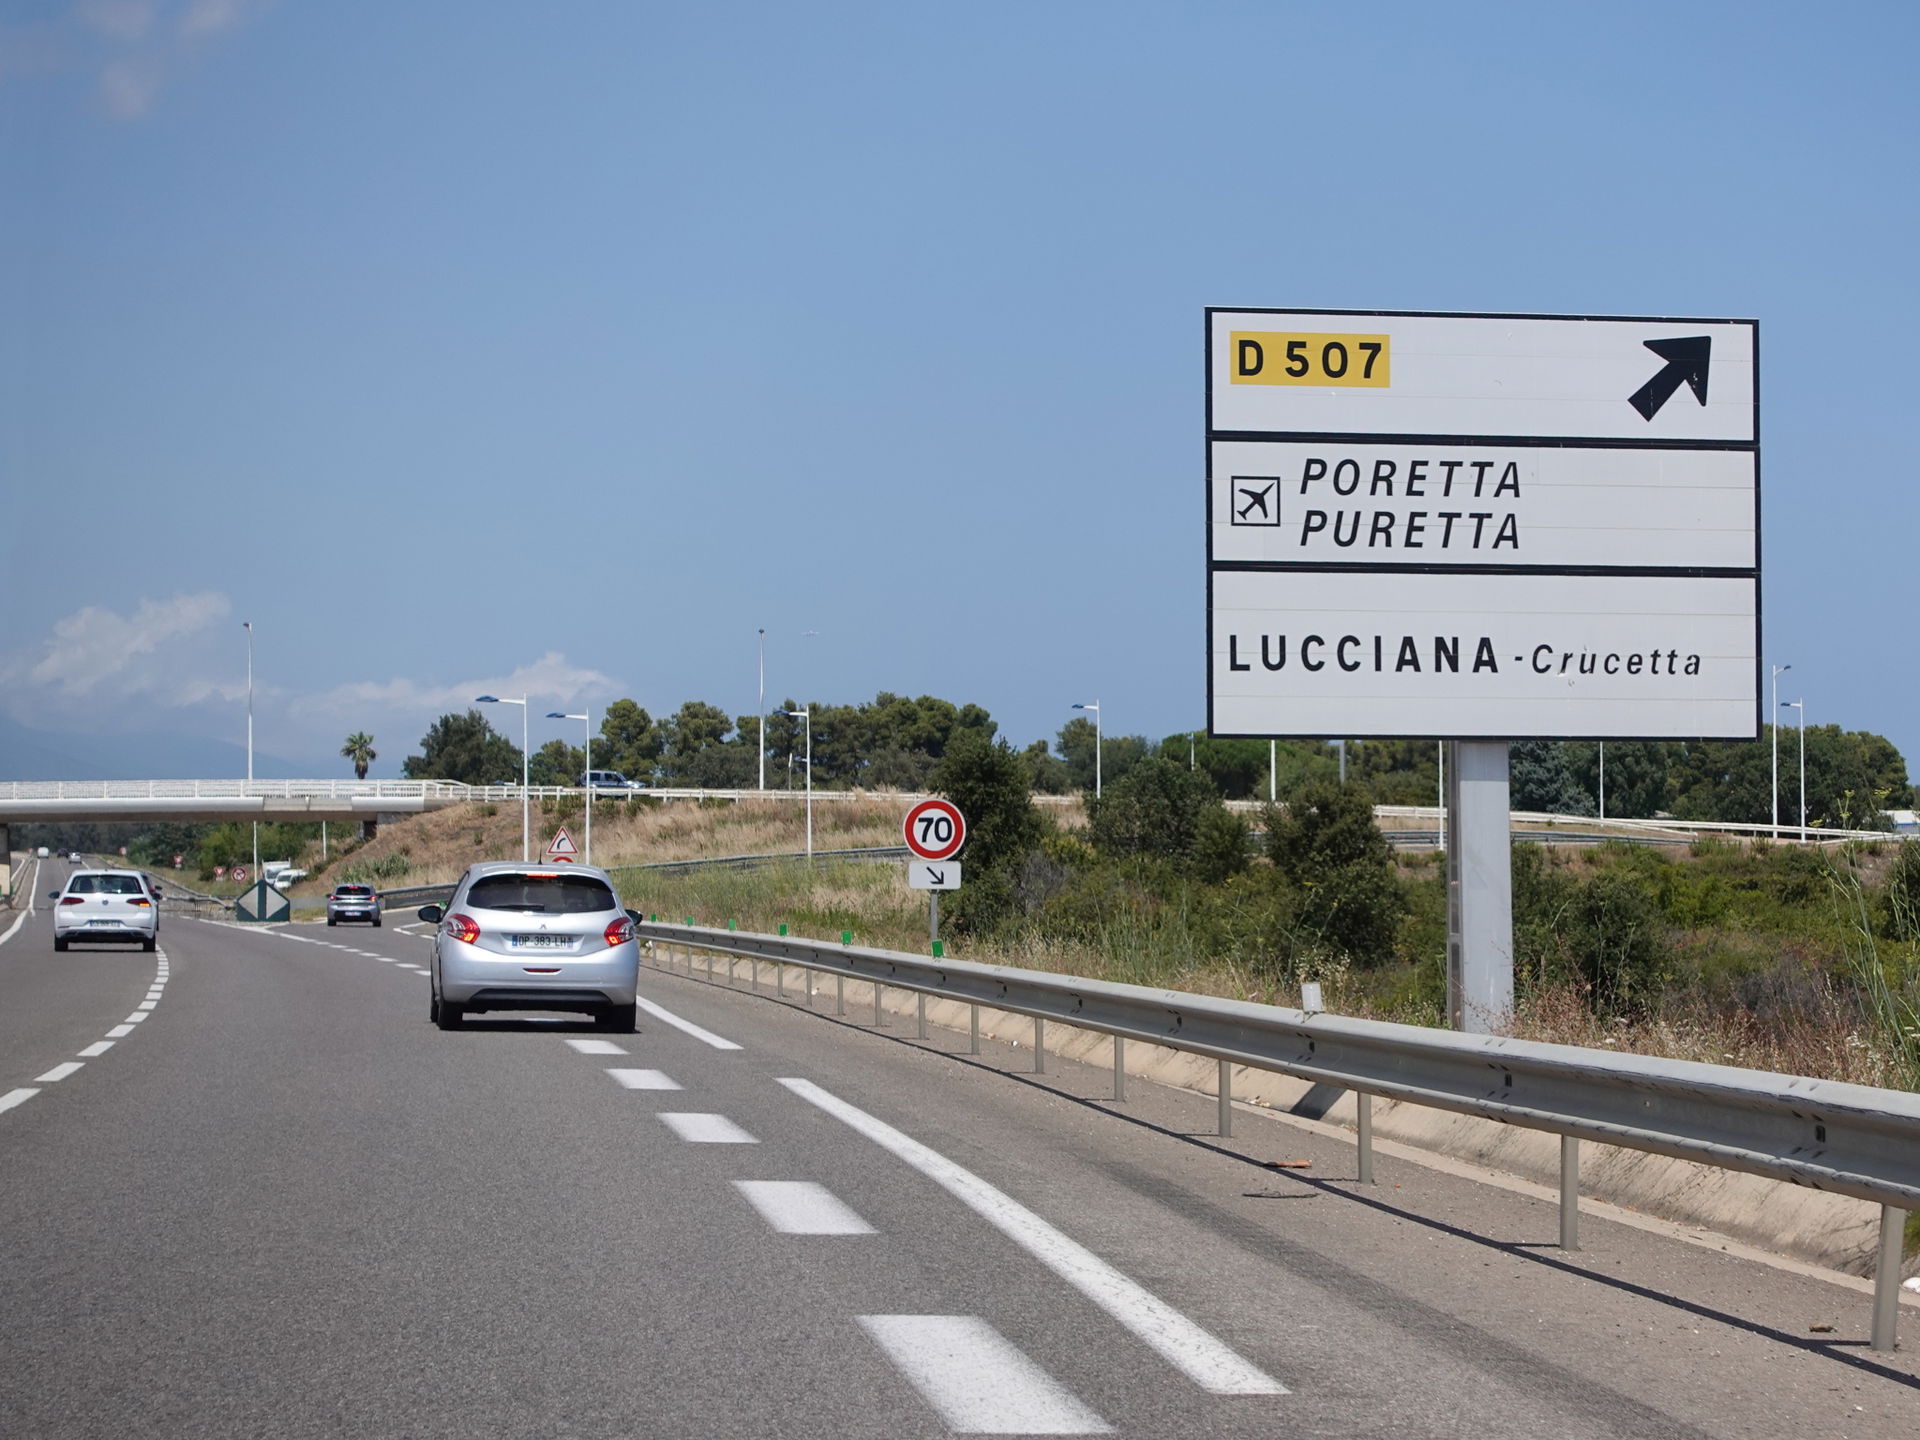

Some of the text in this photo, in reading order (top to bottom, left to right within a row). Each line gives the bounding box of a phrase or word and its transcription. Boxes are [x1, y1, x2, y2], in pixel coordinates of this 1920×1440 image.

[1239, 340, 1381, 378] D 507
[1300, 459, 1519, 497] PORETTA
[1301, 510, 1518, 549] PURETTA
[1230, 635, 1498, 673] LUCCIANA
[919, 817, 952, 842] 70
